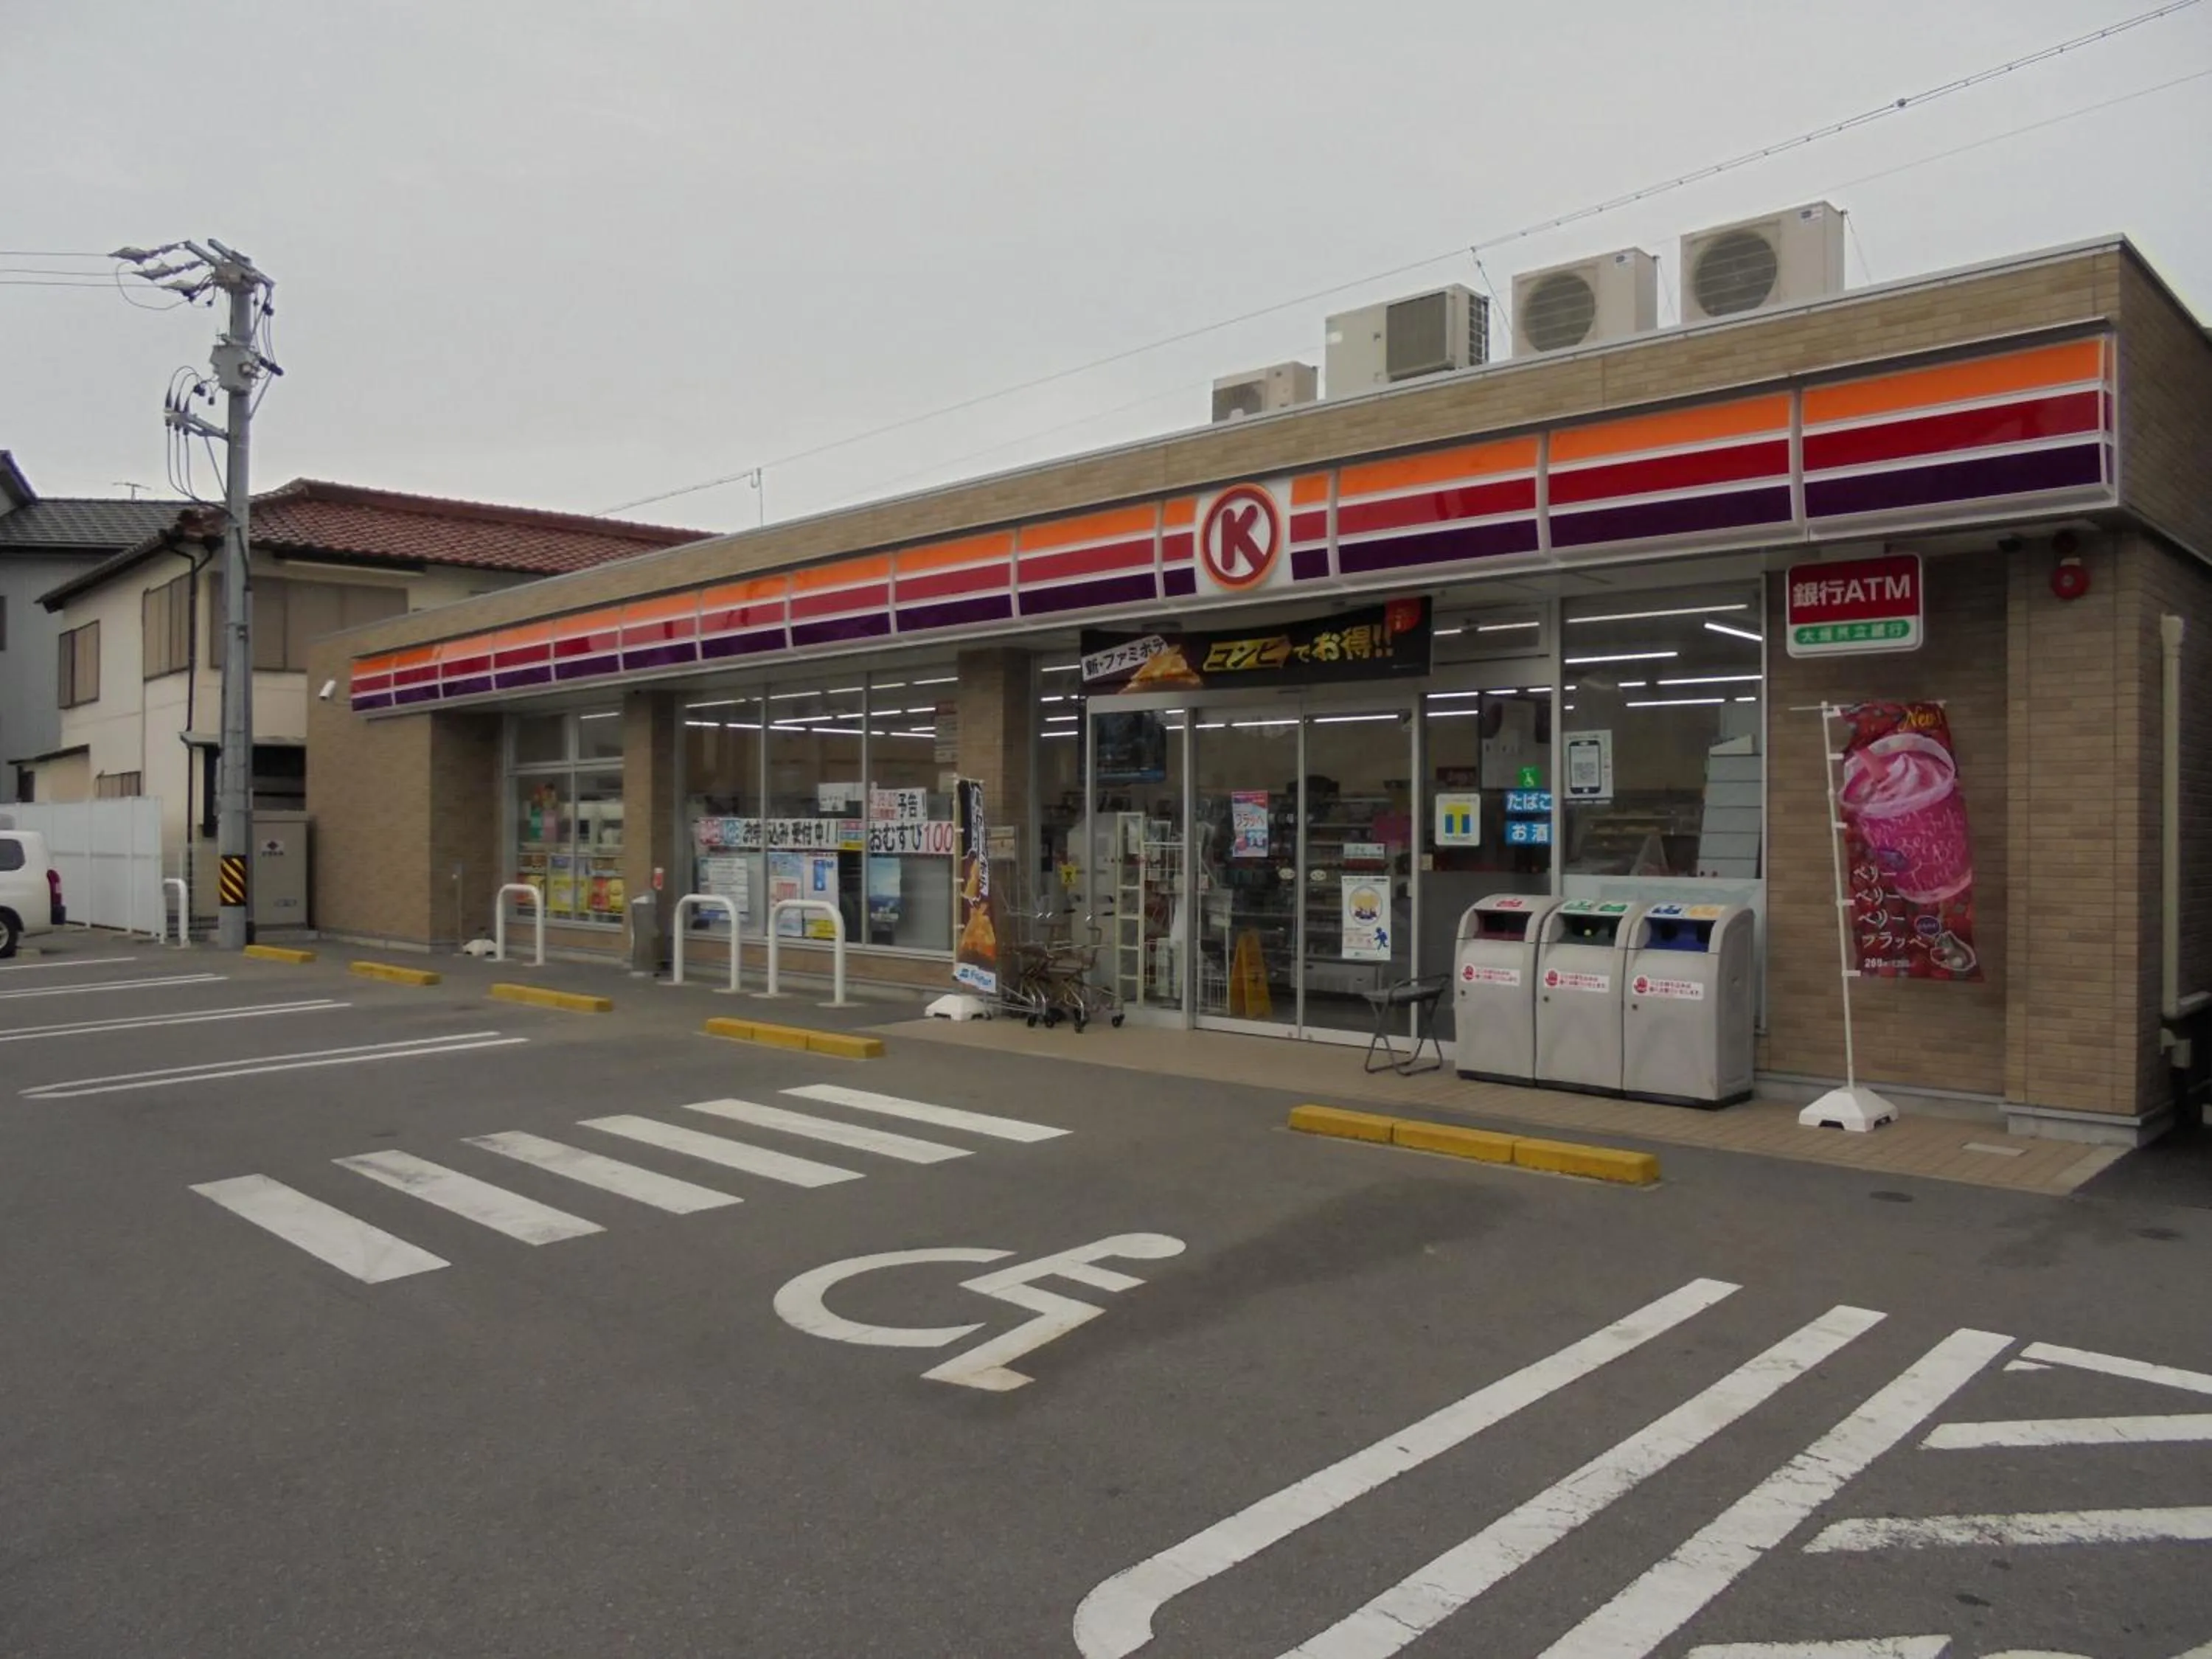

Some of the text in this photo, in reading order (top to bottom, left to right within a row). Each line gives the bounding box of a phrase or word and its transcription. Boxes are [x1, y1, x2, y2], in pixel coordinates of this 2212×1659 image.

[1792, 574, 1911, 608] 銀行ATM
[1507, 793, 1554, 811] たばこ
[1512, 824, 1548, 843] お酒
